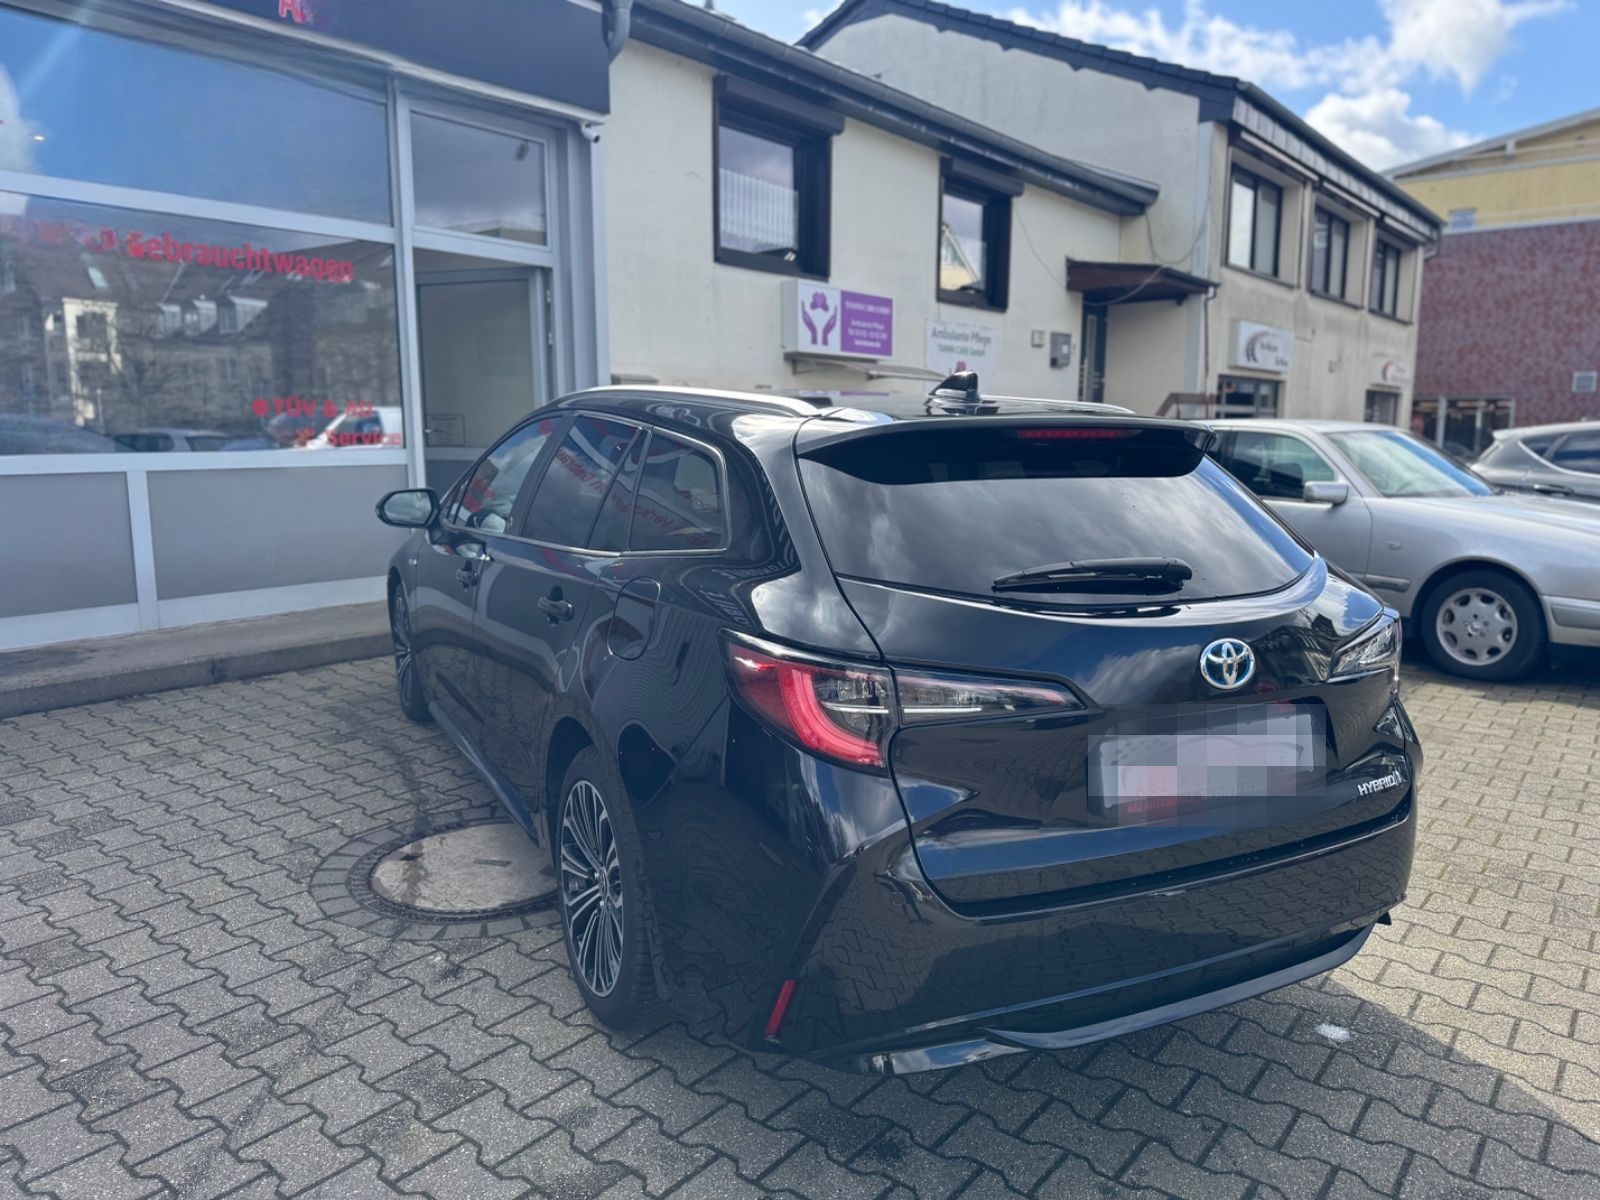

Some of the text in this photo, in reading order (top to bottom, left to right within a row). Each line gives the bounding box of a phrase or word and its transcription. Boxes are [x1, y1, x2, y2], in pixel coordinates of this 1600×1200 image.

[123, 230, 353, 282] Gebrauchtwagen
[272, 395, 317, 417] TÜV
[1357, 774, 1397, 797] HYBRID
